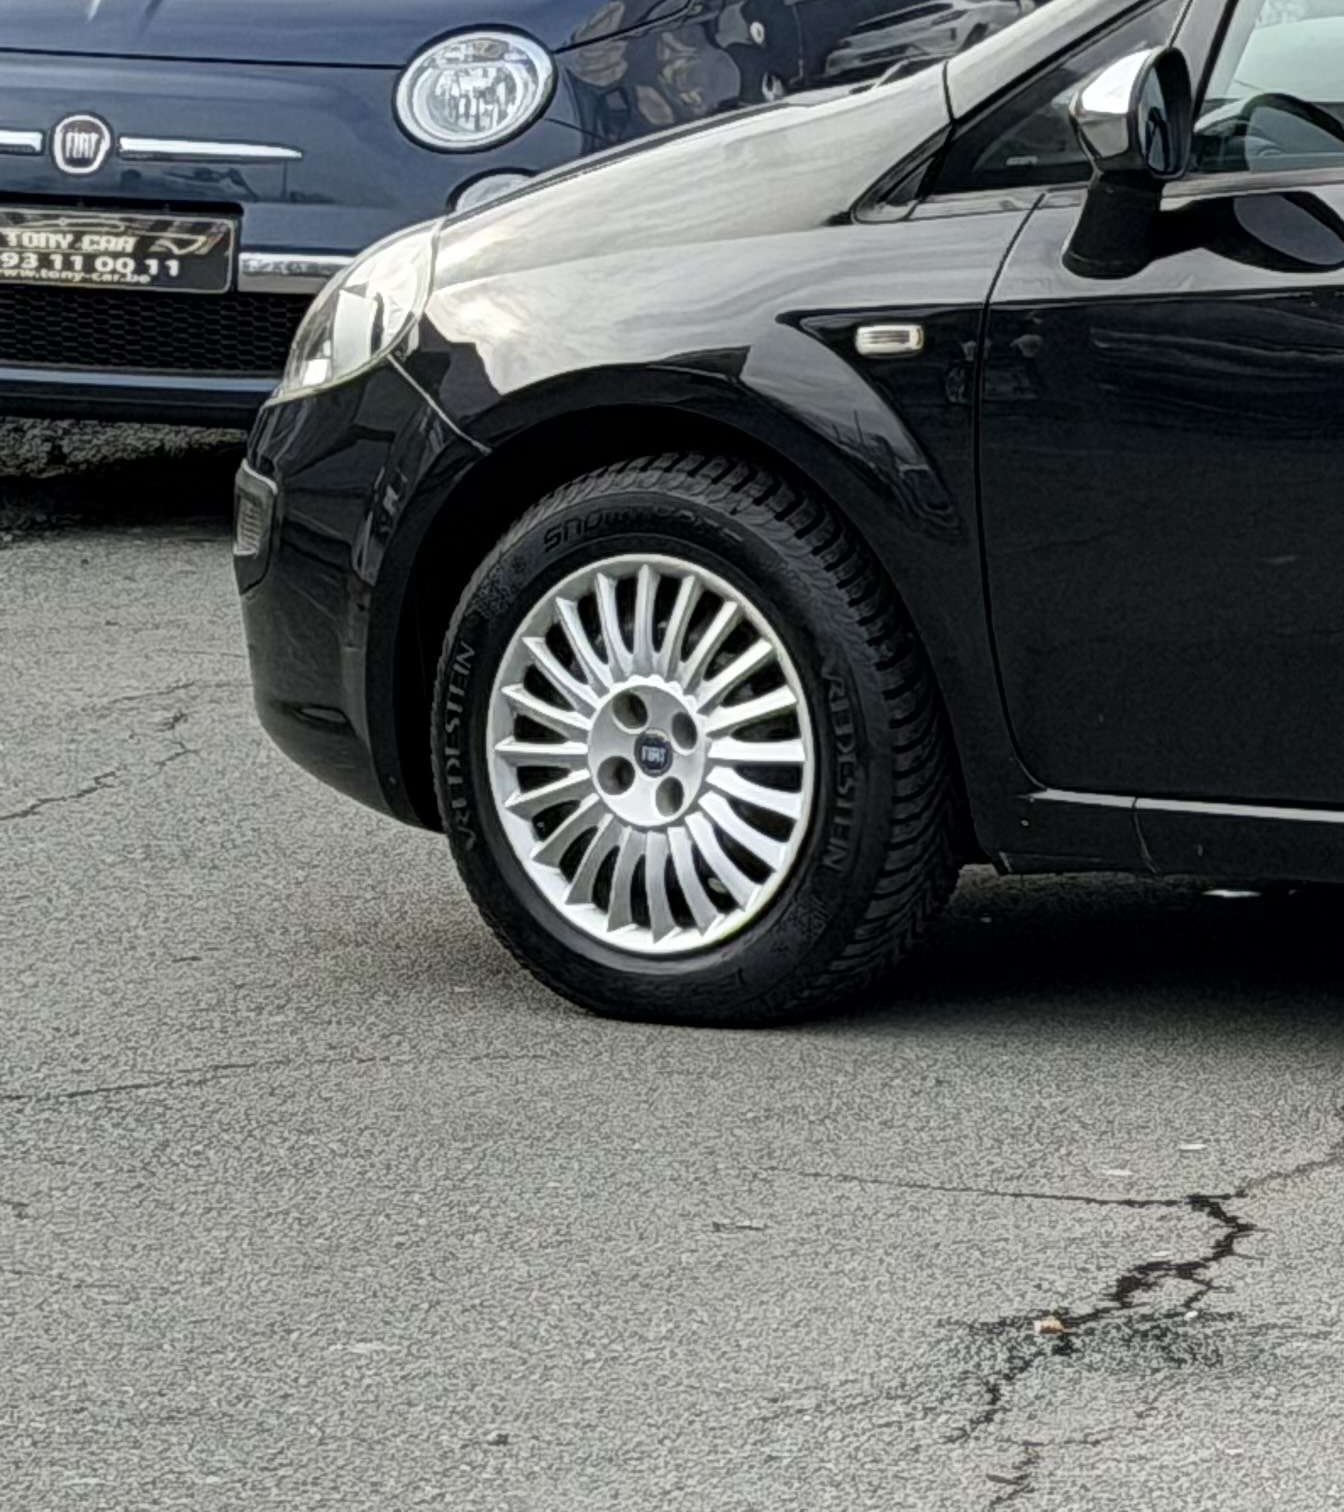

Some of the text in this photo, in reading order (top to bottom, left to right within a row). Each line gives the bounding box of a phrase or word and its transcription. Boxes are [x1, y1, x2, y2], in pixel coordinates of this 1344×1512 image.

[65, 132, 99, 159] FIAT
[2, 232, 139, 253] TONY CAR
[49, 254, 83, 271] 11
[94, 256, 136, 274] 00
[144, 259, 179, 277] 11
